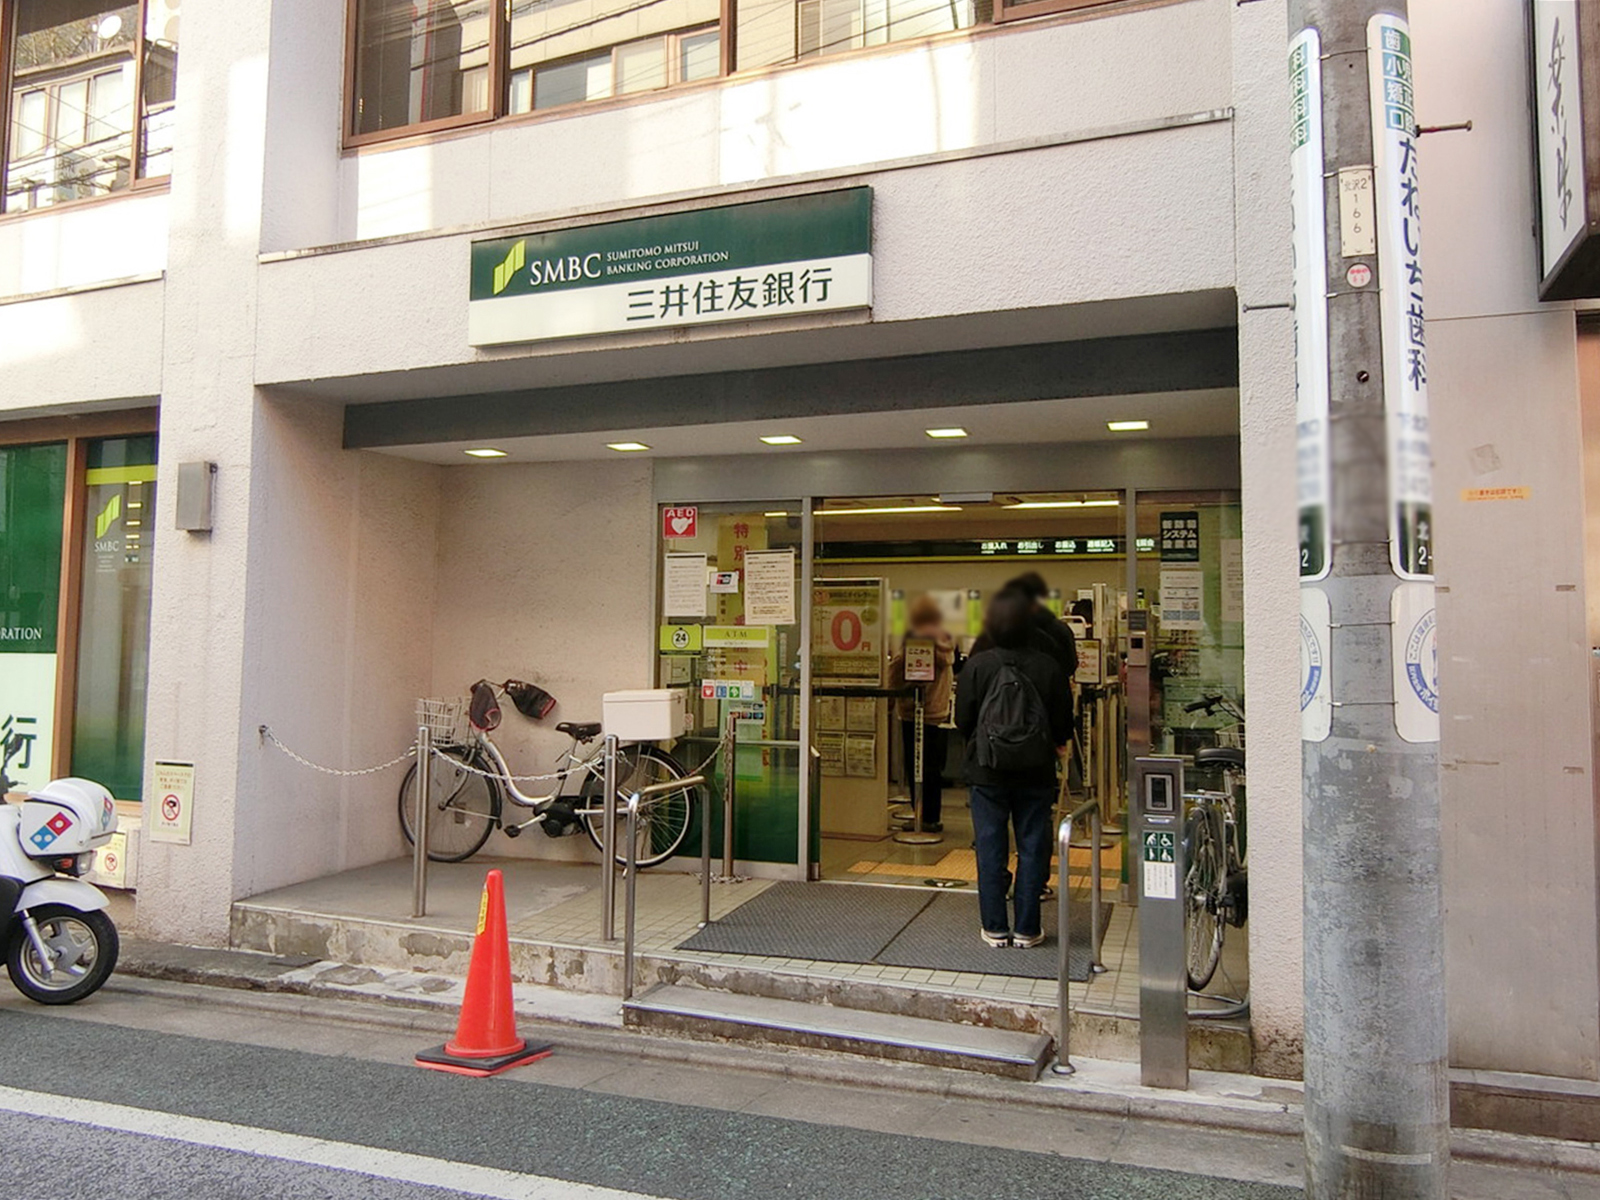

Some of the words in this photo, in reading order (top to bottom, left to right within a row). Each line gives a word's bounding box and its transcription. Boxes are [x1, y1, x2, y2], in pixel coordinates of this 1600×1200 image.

[606, 245, 662, 263] SUMITOMO
[664, 240, 700, 257] MITSUI
[606, 259, 653, 276] BANKING
[655, 251, 730, 271] CORPORATION
[529, 252, 602, 287] SMBC
[626, 267, 834, 322] 三井住友銀行
[666, 508, 694, 518] AED
[1162, 530, 1198, 539] システム
[94, 541, 120, 552] SMBC
[675, 633, 687, 642] 24
[724, 630, 748, 638] ATM
